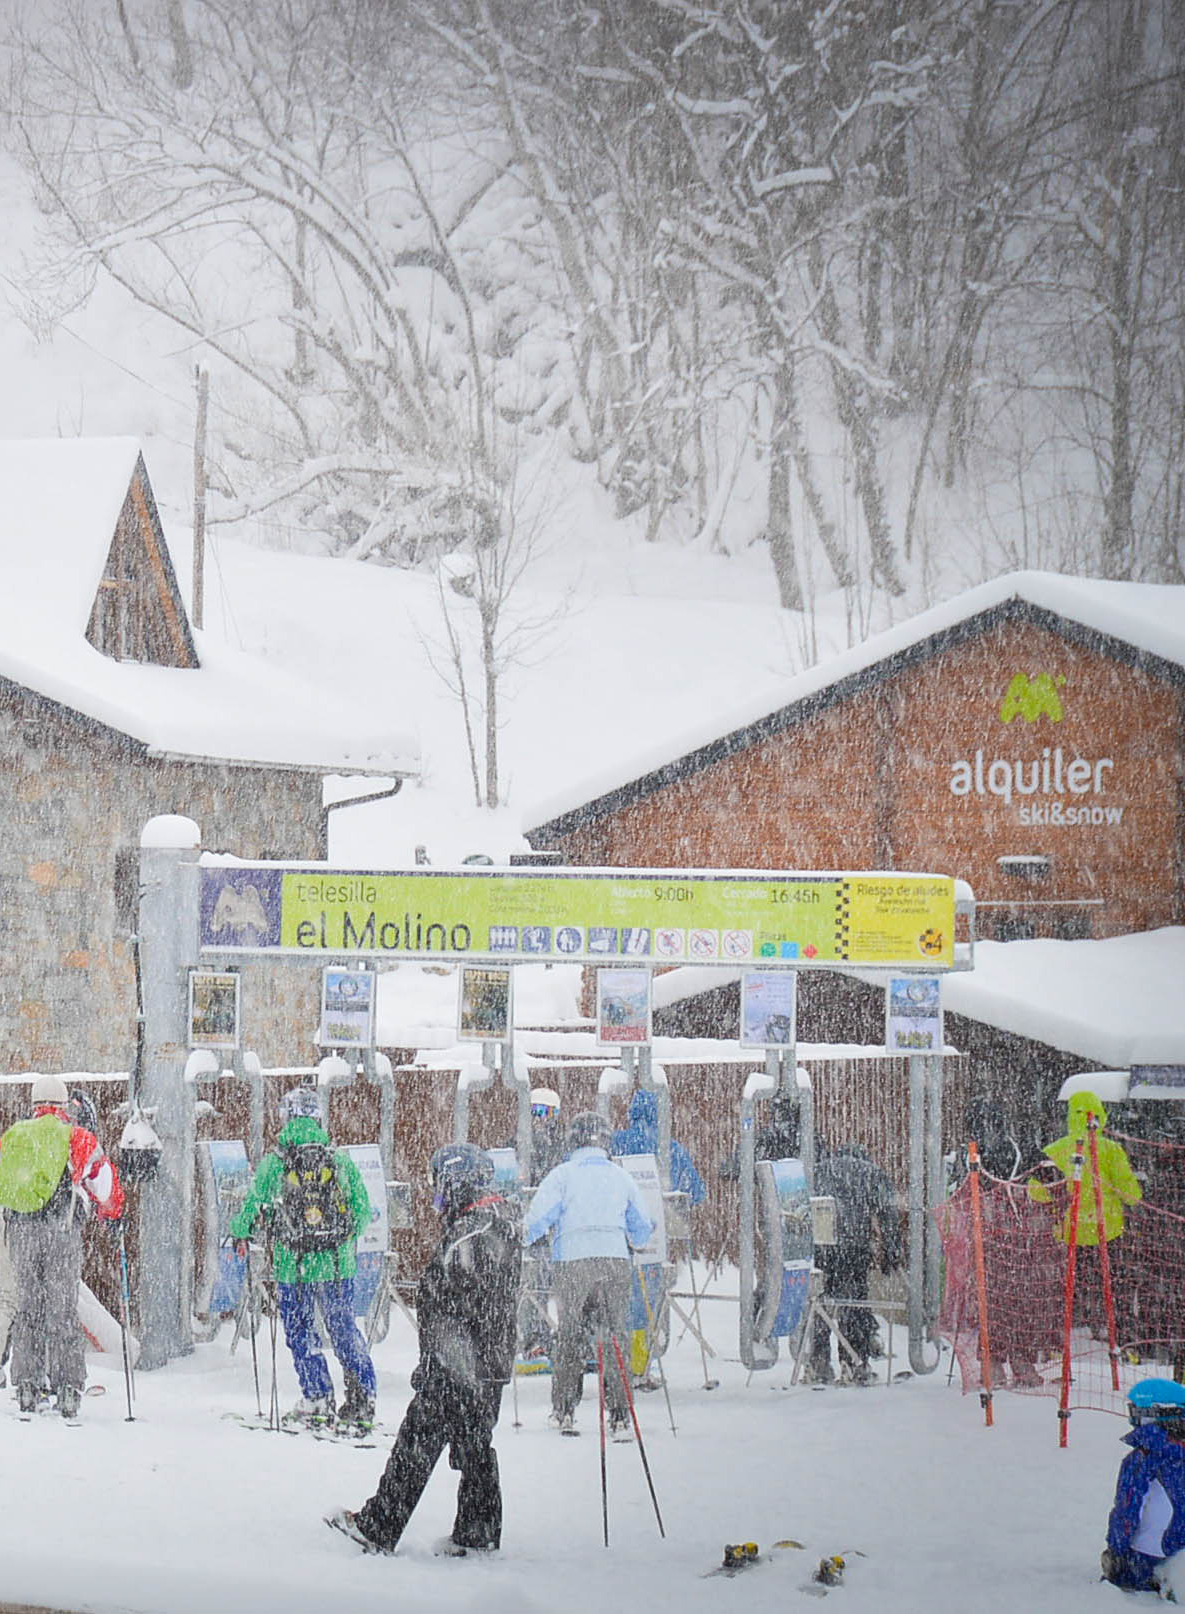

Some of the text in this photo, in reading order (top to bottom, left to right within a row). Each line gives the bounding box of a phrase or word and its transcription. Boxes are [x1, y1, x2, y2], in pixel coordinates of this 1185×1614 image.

[950, 748, 1114, 803] alquiler
[1020, 803, 1123, 825] ski&snow
[296, 880, 377, 904] telesilla
[856, 884, 894, 897] Riesgo
[296, 910, 472, 951] el Molino
